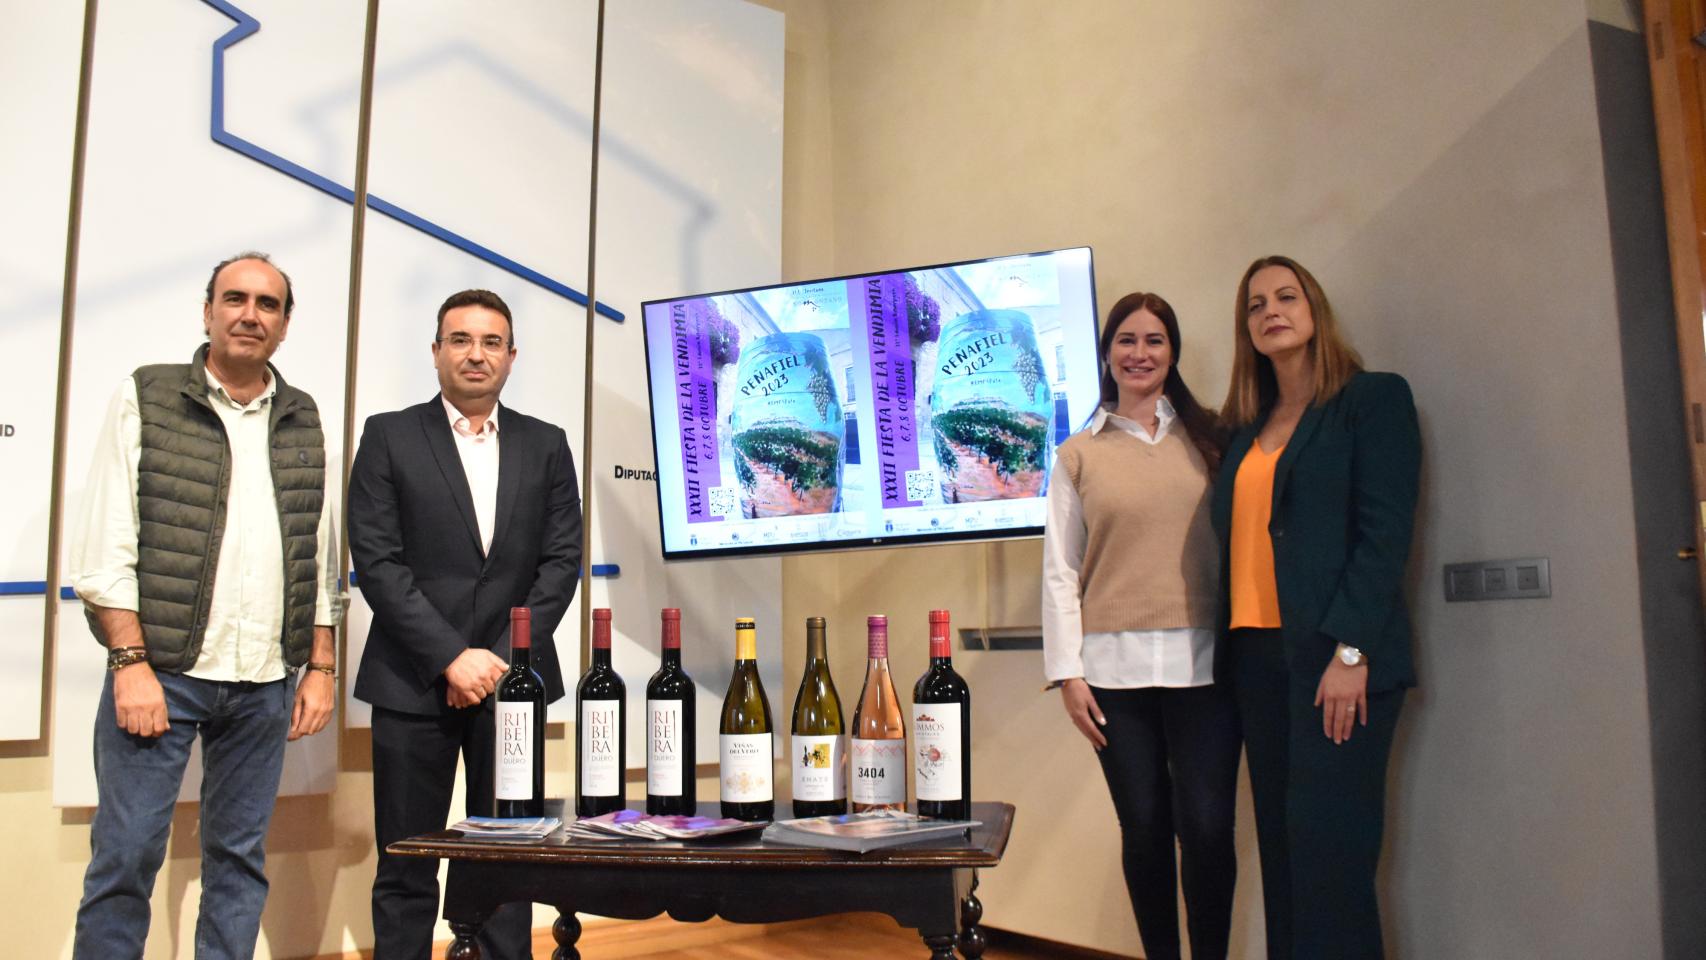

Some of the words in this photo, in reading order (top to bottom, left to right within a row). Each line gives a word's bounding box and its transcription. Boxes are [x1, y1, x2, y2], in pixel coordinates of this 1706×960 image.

[868, 279, 886, 354] VENDIMIA
[673, 303, 690, 376] VENDIMIA
[941, 332, 1007, 375] PEÑAFIEL
[964, 351, 994, 376] 2023
[740, 355, 801, 396] PEÑAFIEL
[874, 360, 889, 377] LA
[679, 382, 693, 398] LA
[761, 373, 789, 397] 2023
[877, 382, 890, 402] DE
[894, 360, 908, 412] OCTUBRE
[681, 402, 694, 422] DE
[697, 380, 711, 431] OCTUBRE
[879, 407, 895, 457] FIESTA
[683, 426, 699, 474] FIESTA
[883, 461, 898, 501] XXXII
[688, 478, 702, 518] XXXII
[504, 727, 522, 741] BE
[592, 725, 610, 739] BE
[654, 725, 671, 738] BE
[504, 742, 523, 755] RA
[592, 740, 611, 753] RA
[654, 740, 672, 753] RA
[858, 767, 885, 779] 3404
